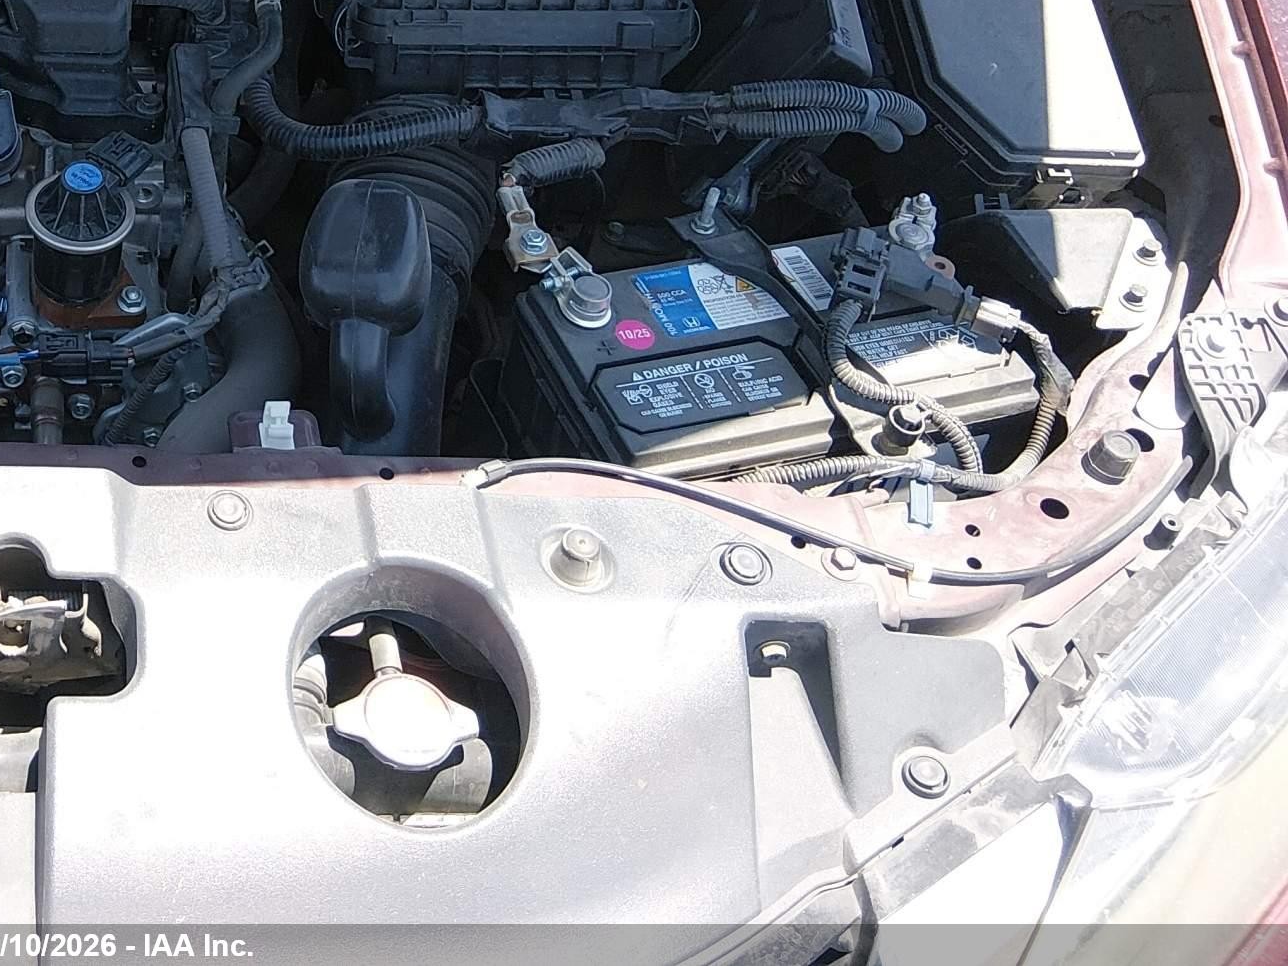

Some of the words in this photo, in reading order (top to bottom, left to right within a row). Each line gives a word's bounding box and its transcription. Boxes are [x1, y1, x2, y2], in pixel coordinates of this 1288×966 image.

[618, 329, 651, 340] 10/25
[643, 363, 692, 379] DANGER
[695, 361, 702, 370] /
[704, 354, 749, 369] POISON
[649, 392, 683, 403] EXPLOSIVE
